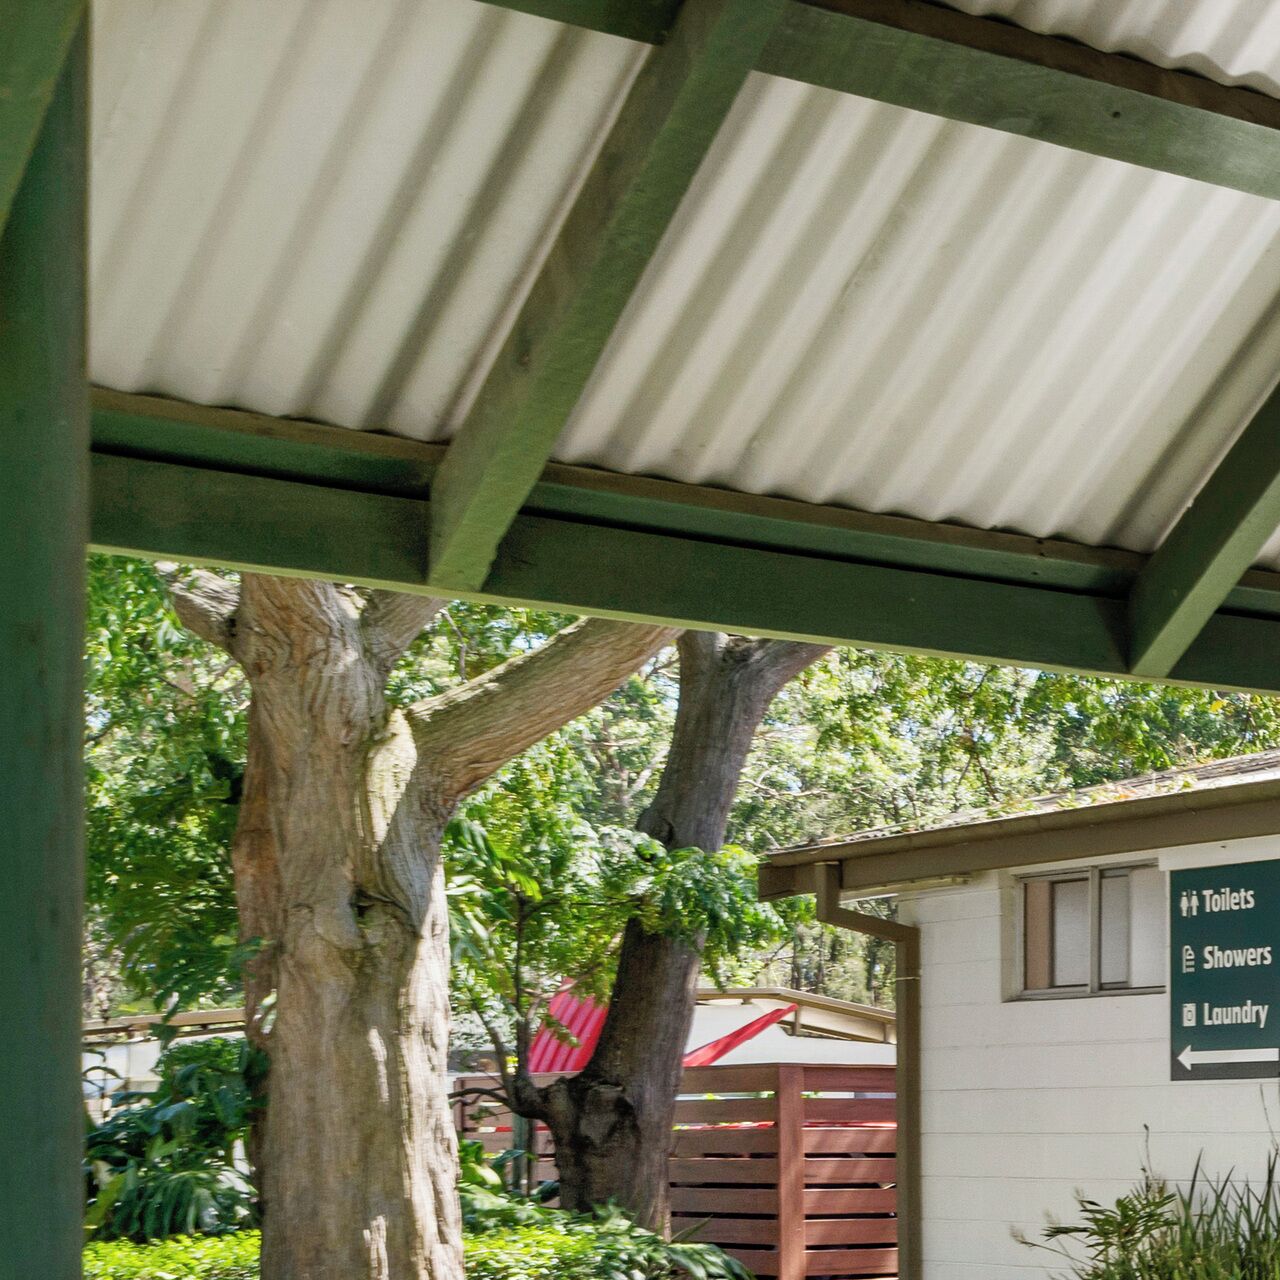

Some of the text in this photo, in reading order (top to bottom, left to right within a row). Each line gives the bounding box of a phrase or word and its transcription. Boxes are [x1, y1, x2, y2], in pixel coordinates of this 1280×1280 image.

[1202, 887, 1255, 912] Toilets
[1203, 946, 1272, 970] Showers
[1203, 1000, 1269, 1028] Laundry
